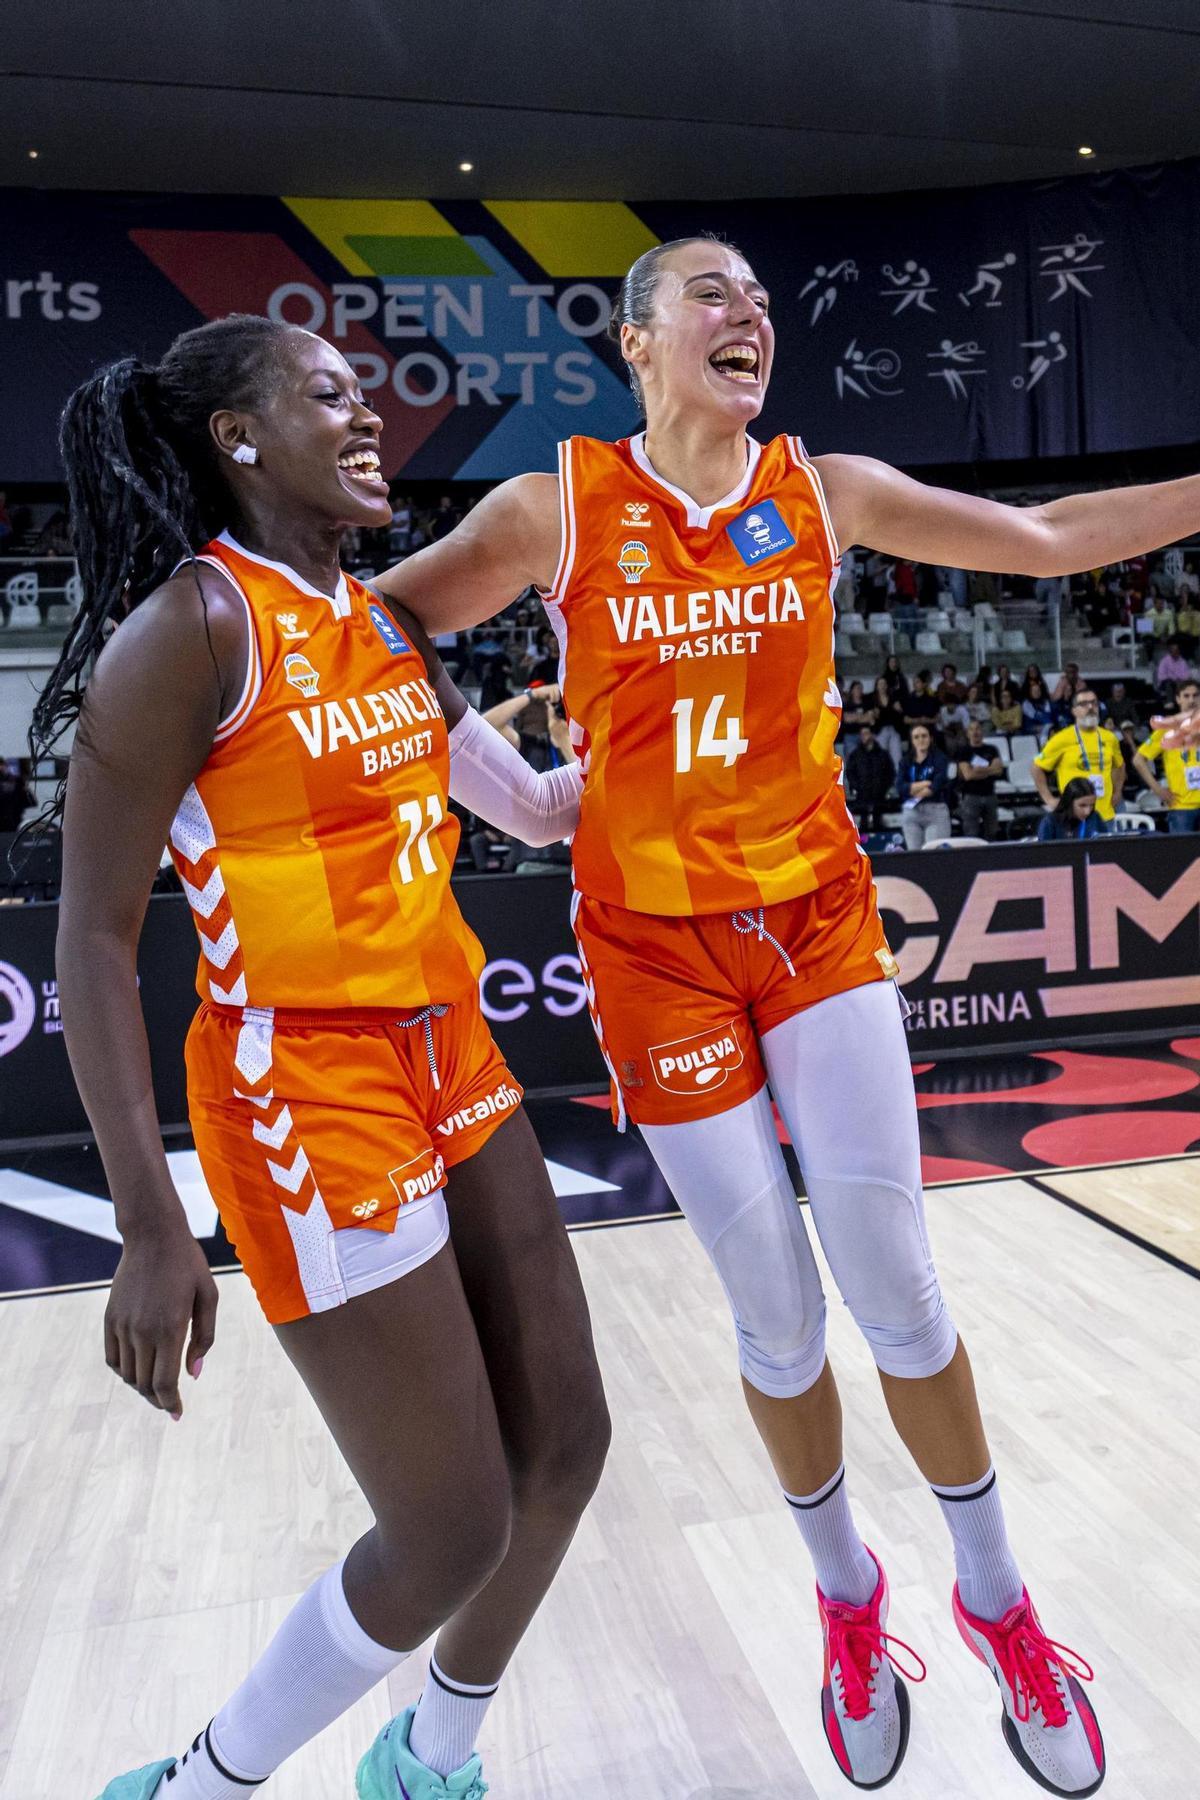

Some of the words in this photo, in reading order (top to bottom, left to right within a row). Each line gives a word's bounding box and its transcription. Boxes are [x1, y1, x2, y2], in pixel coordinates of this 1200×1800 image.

[267, 282, 484, 338] OPEN
[510, 283, 612, 338] TO
[344, 351, 597, 407] PORTS
[607, 577, 805, 643] VALENCIA
[659, 631, 763, 664] BASKET
[287, 678, 446, 760] VALENCIA
[671, 694, 749, 773] 14
[361, 730, 433, 777] BASKET
[906, 1016, 927, 1031] LA
[928, 990, 1033, 1030] REINA
[658, 1037, 736, 1079] PULEVA
[402, 1154, 444, 1203] PULE
